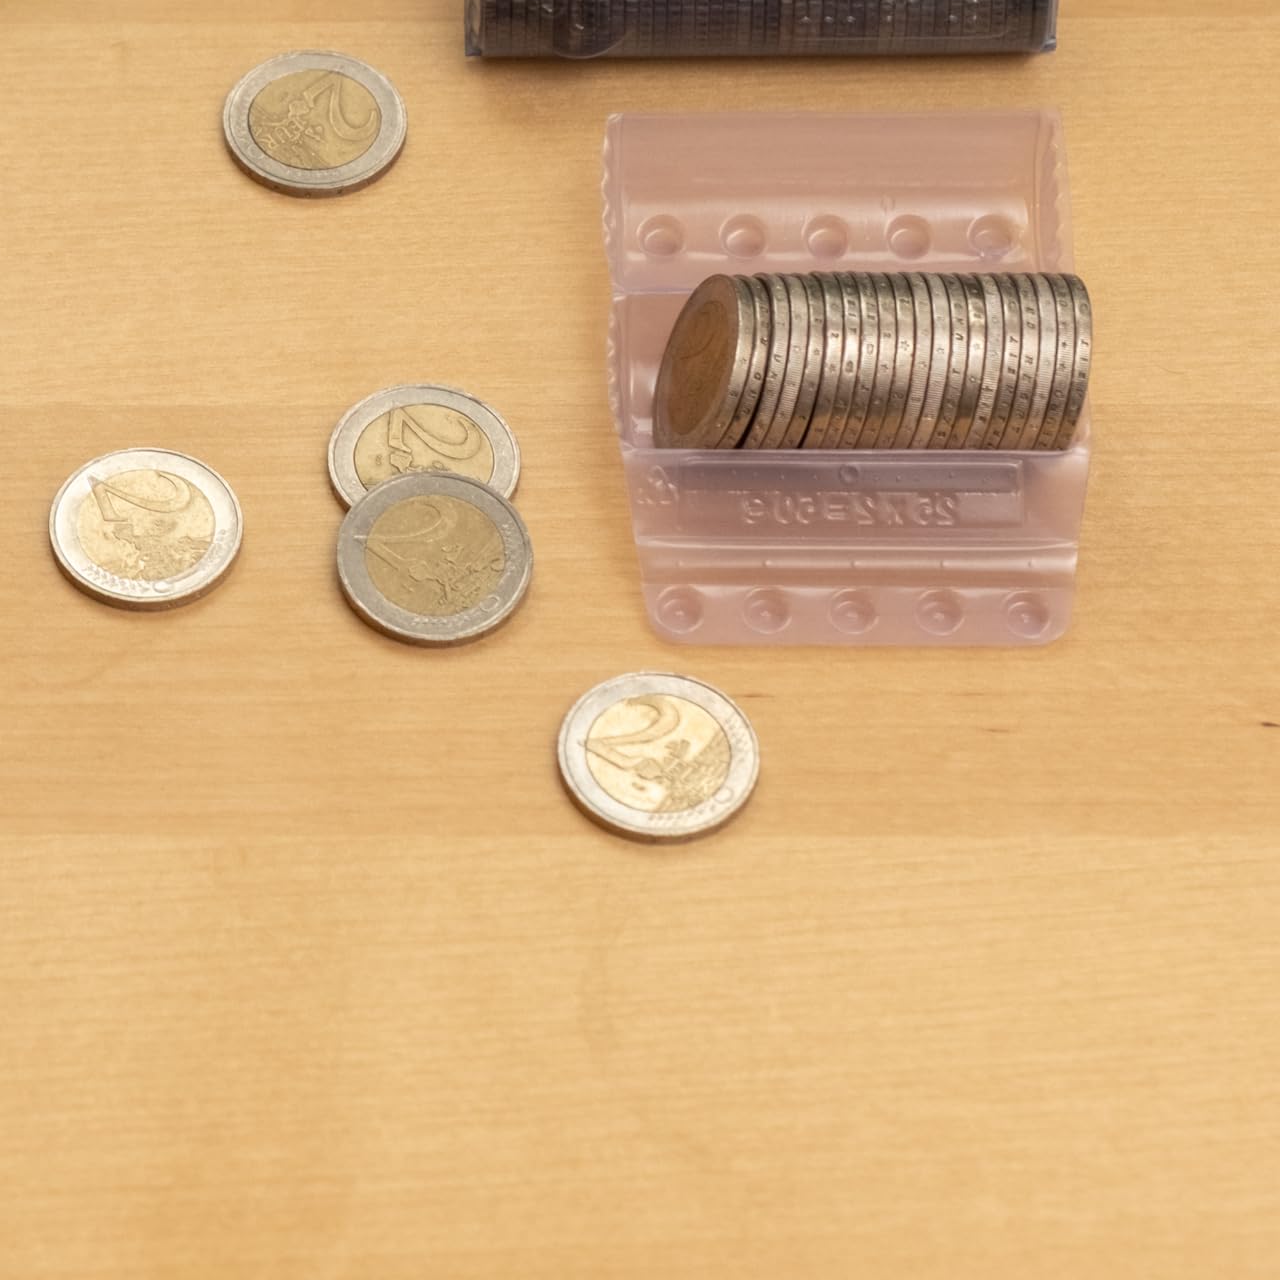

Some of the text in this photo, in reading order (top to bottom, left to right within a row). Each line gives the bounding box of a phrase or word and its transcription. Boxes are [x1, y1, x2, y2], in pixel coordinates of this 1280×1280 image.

[302, 70, 378, 141] 2
[387, 404, 482, 460] 2
[87, 470, 192, 522] 2
[353, 502, 458, 571] 2
[577, 695, 681, 772] 2
